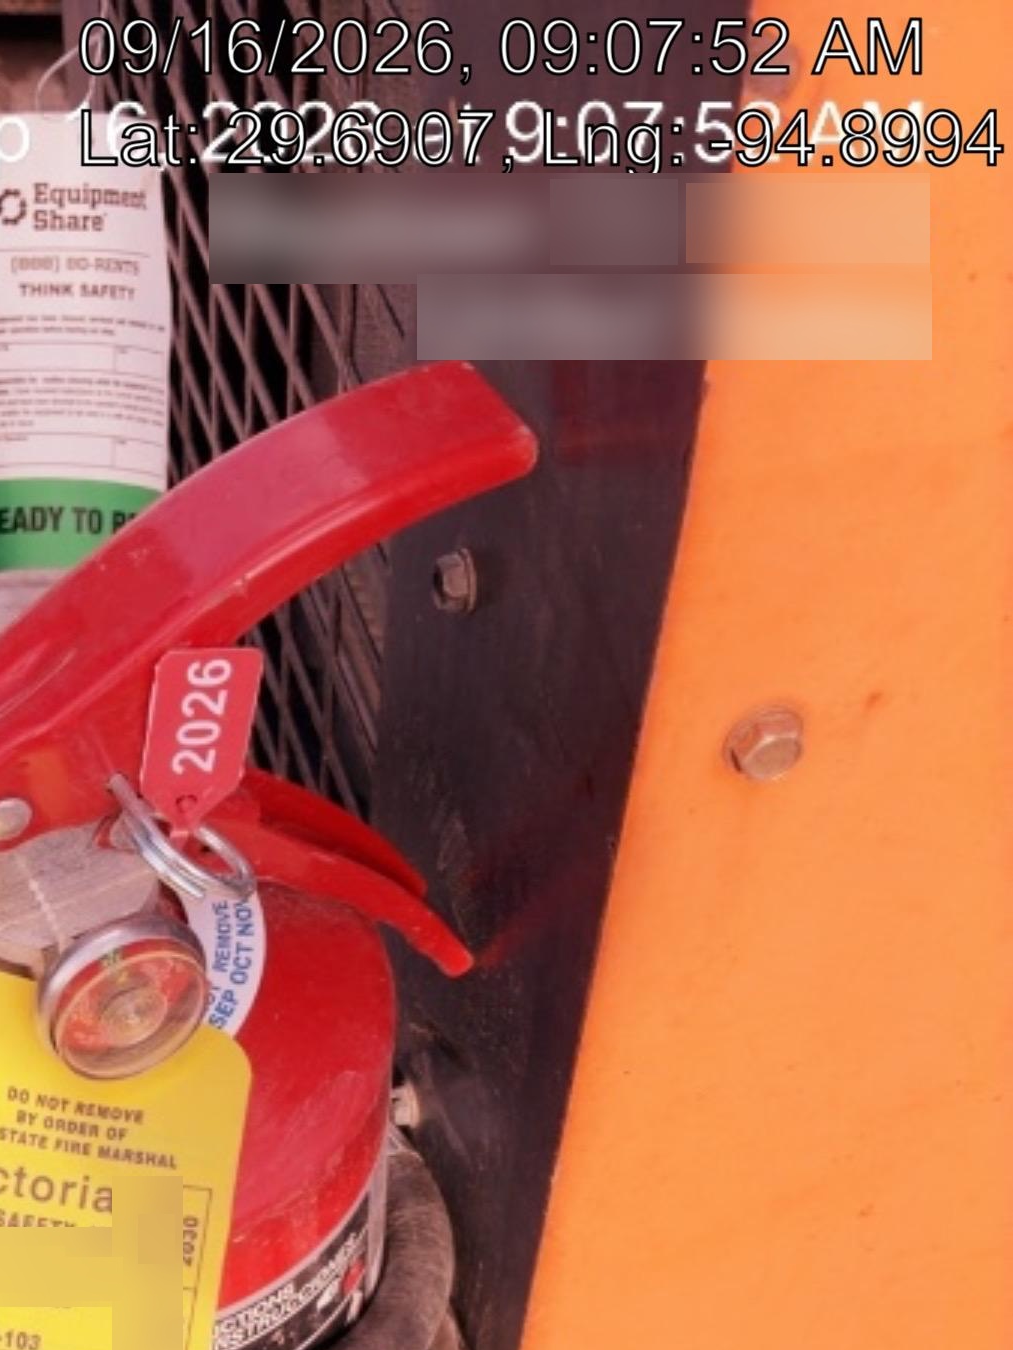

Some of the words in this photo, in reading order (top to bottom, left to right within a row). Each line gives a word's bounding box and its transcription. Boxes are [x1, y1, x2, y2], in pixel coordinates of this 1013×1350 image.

[33, 182, 147, 210] Equipment
[33, 209, 105, 231] Share
[19, 283, 73, 298] THINK
[80, 284, 135, 301] SAFETY
[72, 507, 102, 534] TO
[171, 658, 233, 775] 2026
[211, 899, 229, 973] REMOVE
[208, 989, 238, 1031] SEP
[233, 938, 254, 986] OCT
[7, 1086, 30, 1102] DO
[36, 1093, 69, 1111] NOT
[74, 1099, 144, 1124] REMOVE
[16, 1110, 36, 1126] BY
[43, 1115, 100, 1137] ORDER
[106, 1126, 128, 1142] OF
[53, 1136, 91, 1156] FIRE
[98, 1141, 178, 1169] MARSHAL
